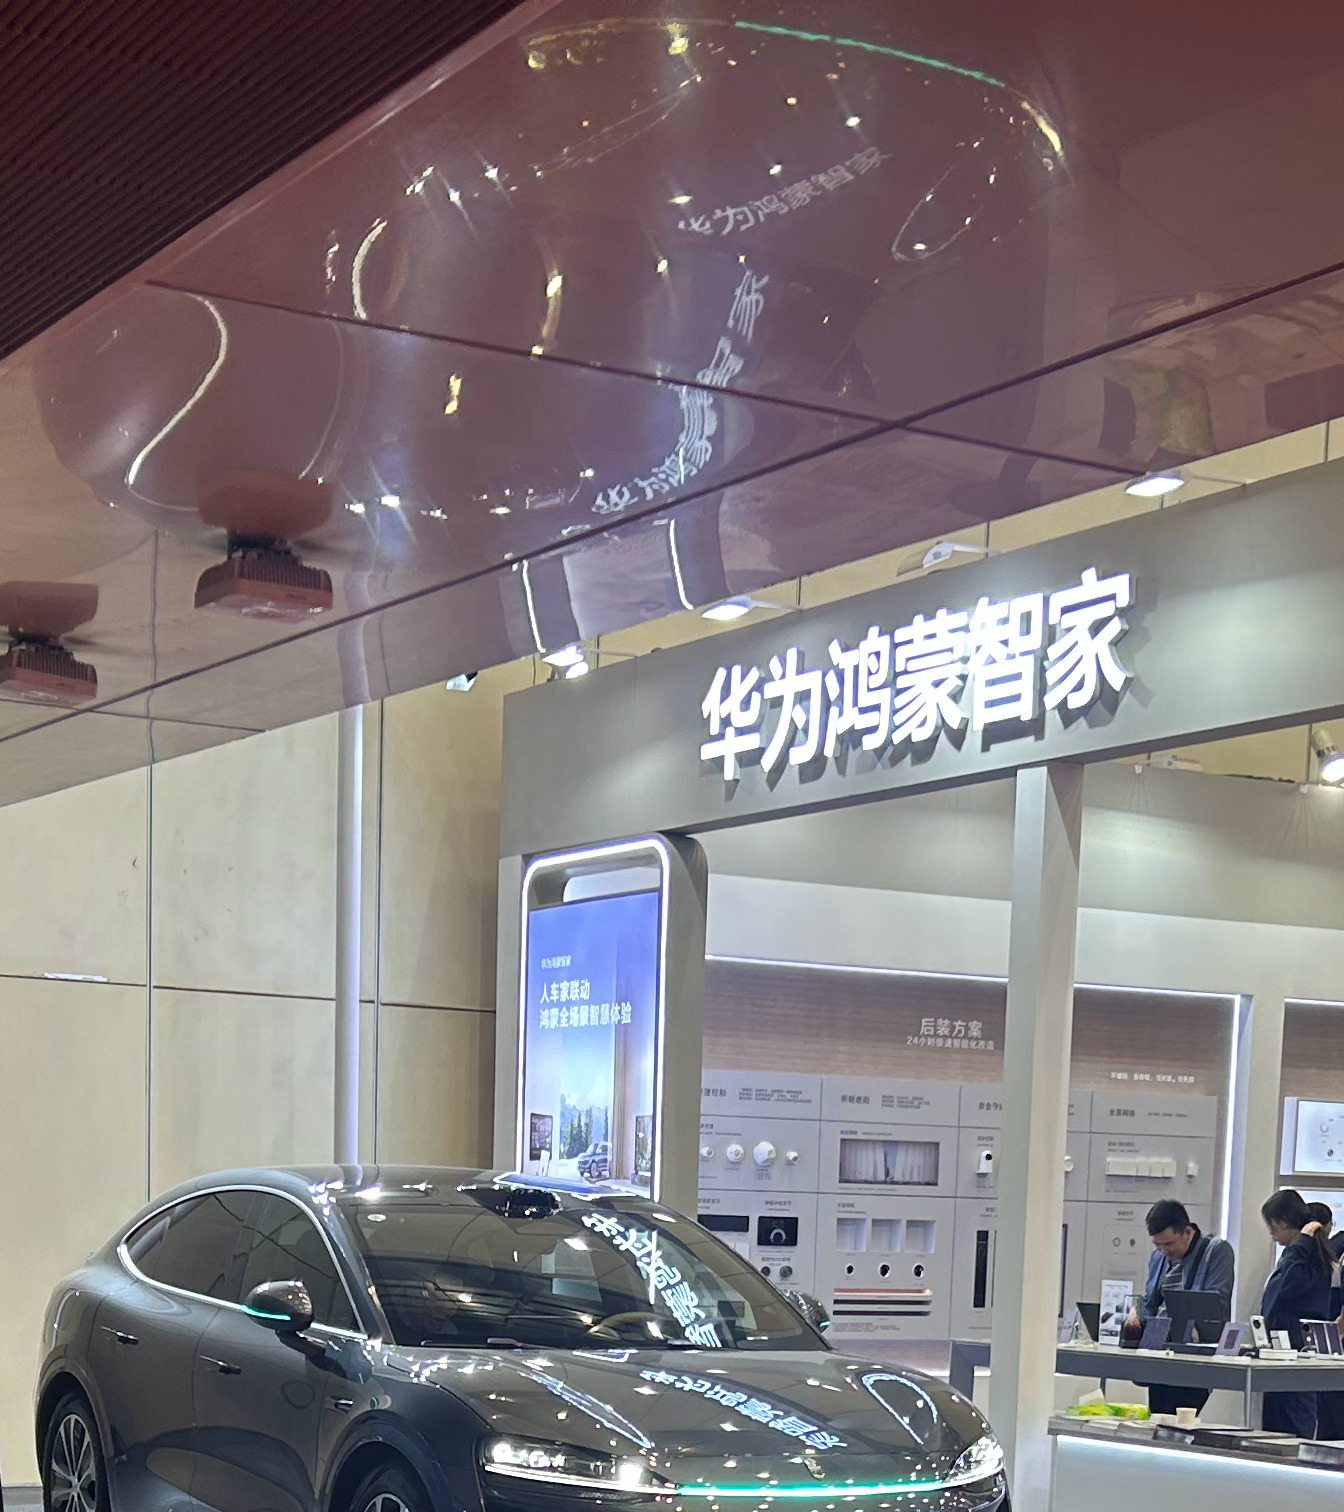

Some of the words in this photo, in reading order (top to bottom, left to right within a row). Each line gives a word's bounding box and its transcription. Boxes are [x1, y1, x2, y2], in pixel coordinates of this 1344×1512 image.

[699, 566, 1135, 782] 华为鸿蒙智家
[539, 979, 591, 1005] 人车家联动
[539, 1001, 632, 1030] 鸿蒙全场景智慧体验
[919, 1017, 983, 1039] 后装方案
